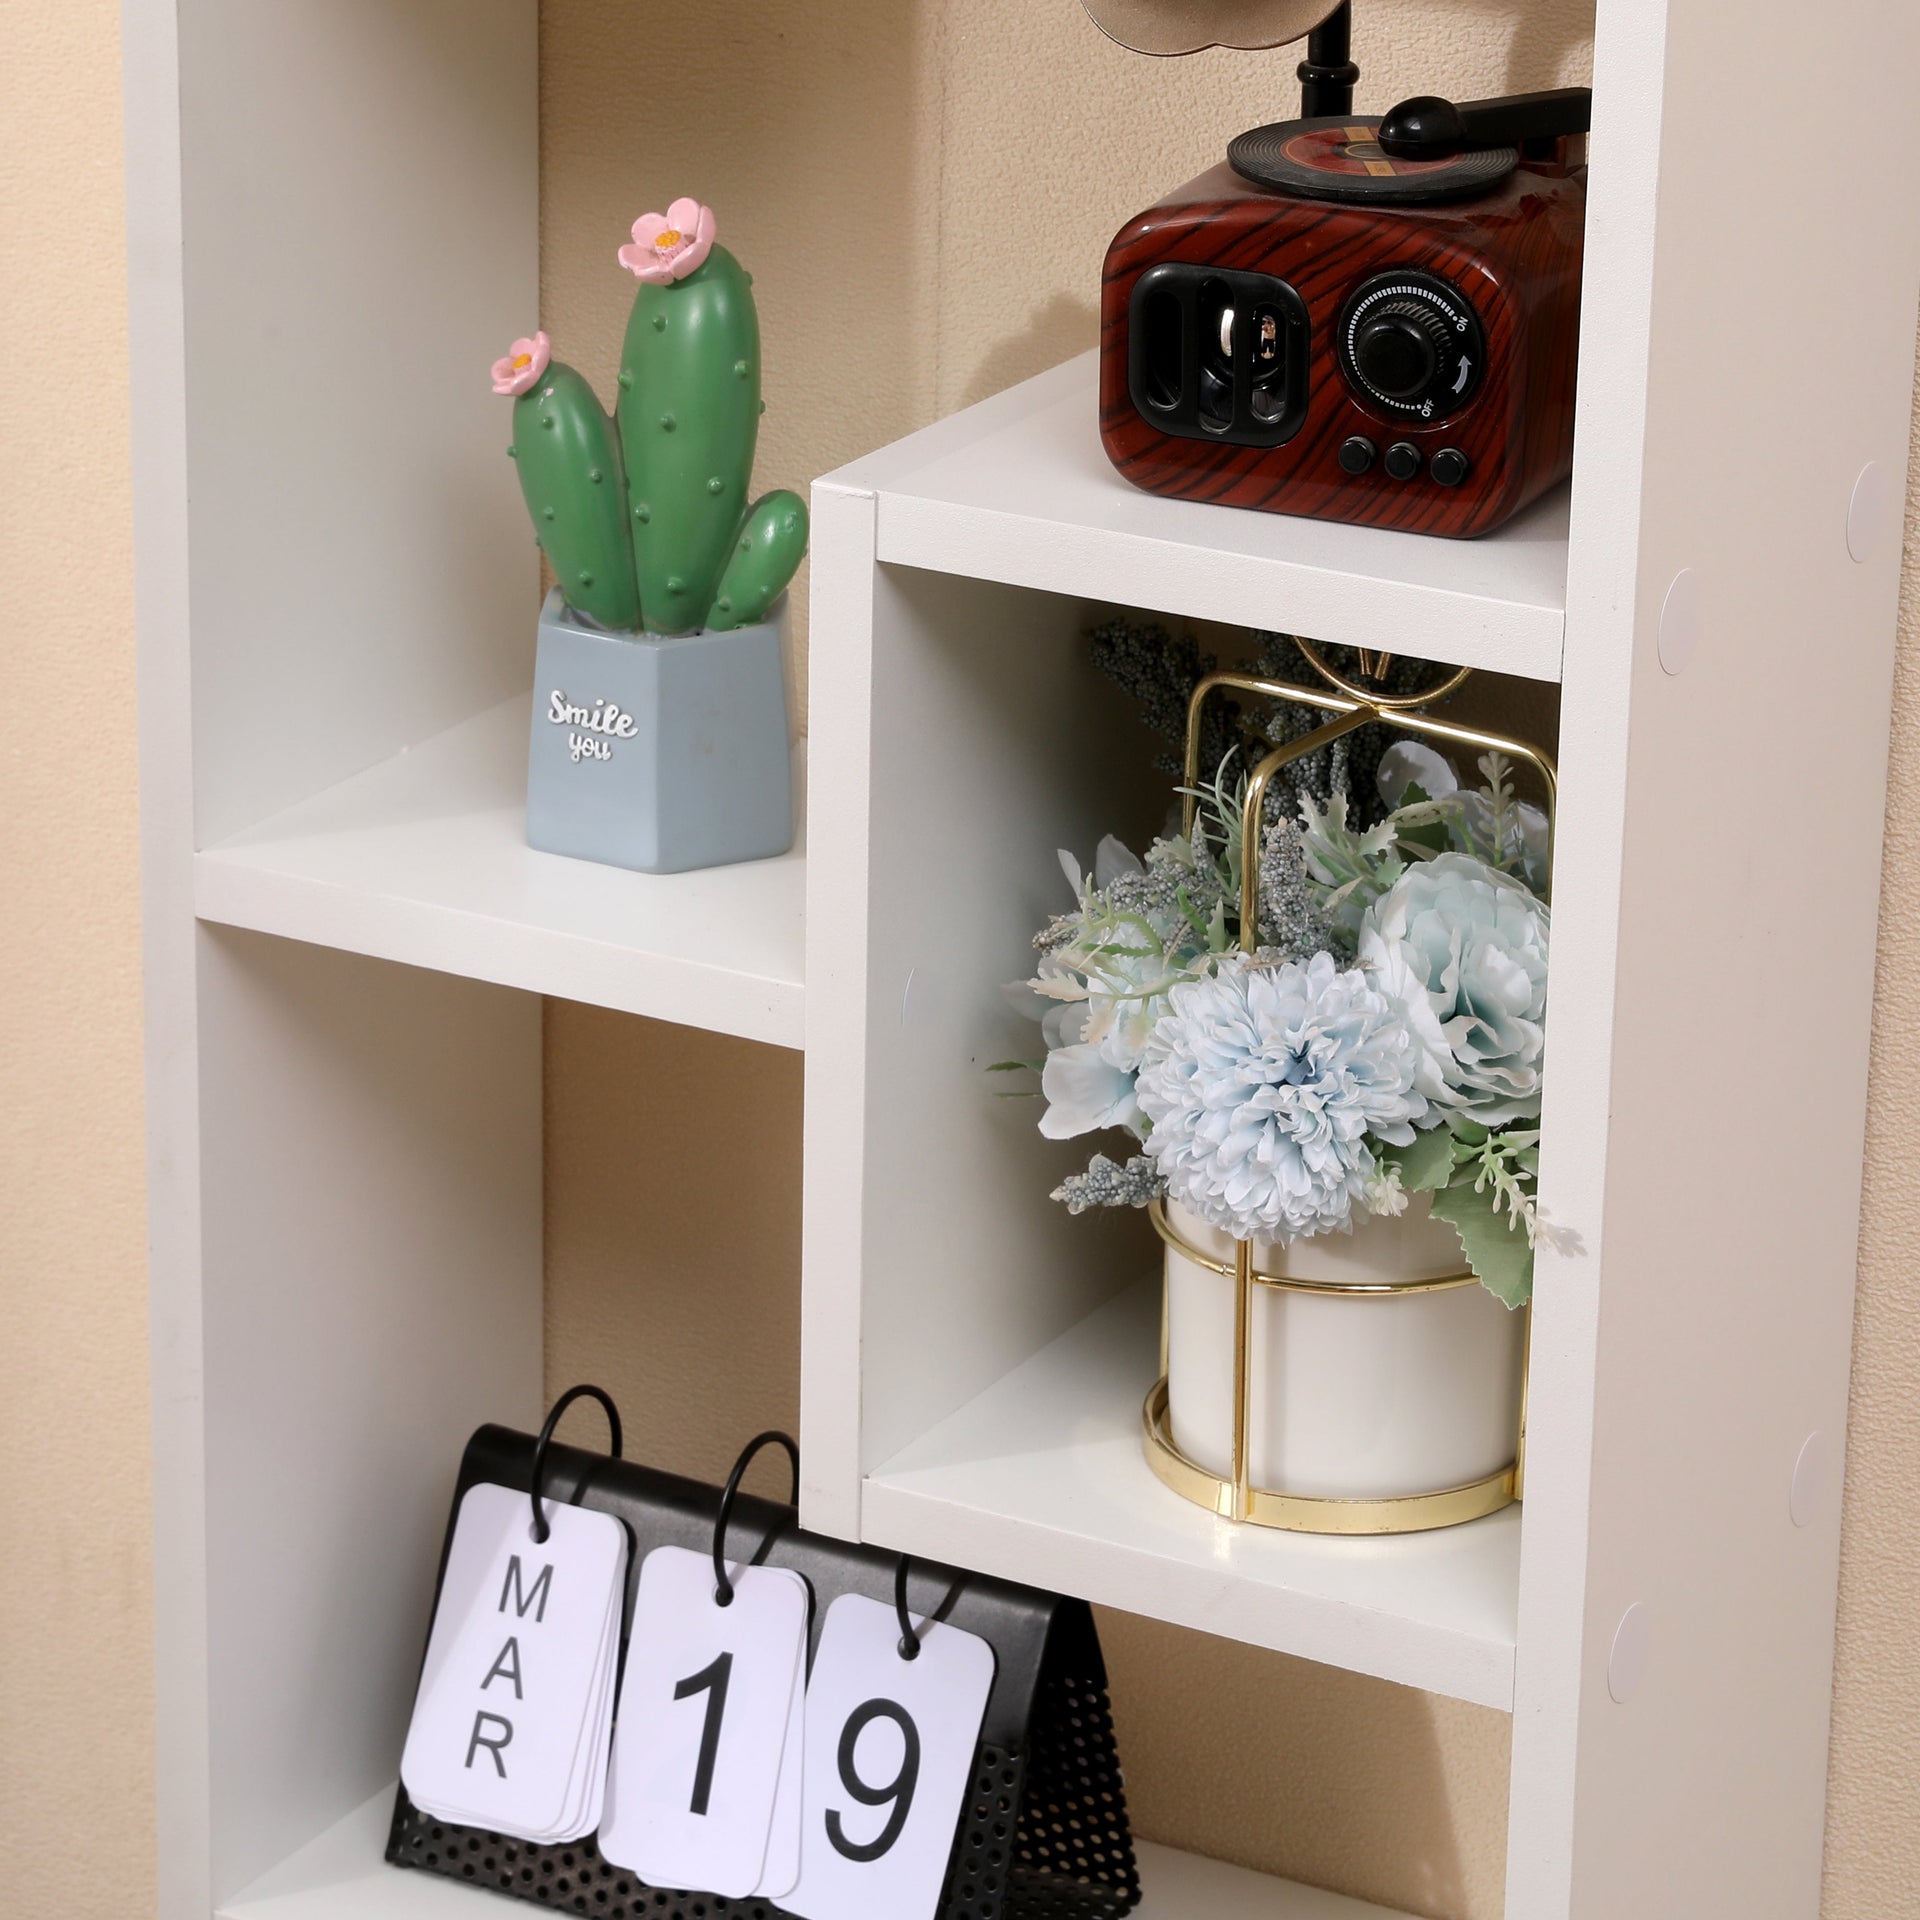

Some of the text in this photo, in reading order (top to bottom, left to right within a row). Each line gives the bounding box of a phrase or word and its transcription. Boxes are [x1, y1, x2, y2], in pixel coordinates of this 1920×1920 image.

[1456, 316, 1468, 332] ON
[1421, 399, 1434, 417] OFF
[548, 690, 639, 738] Smile
[569, 733, 612, 762] you
[463, 1554, 553, 1779] MAR
